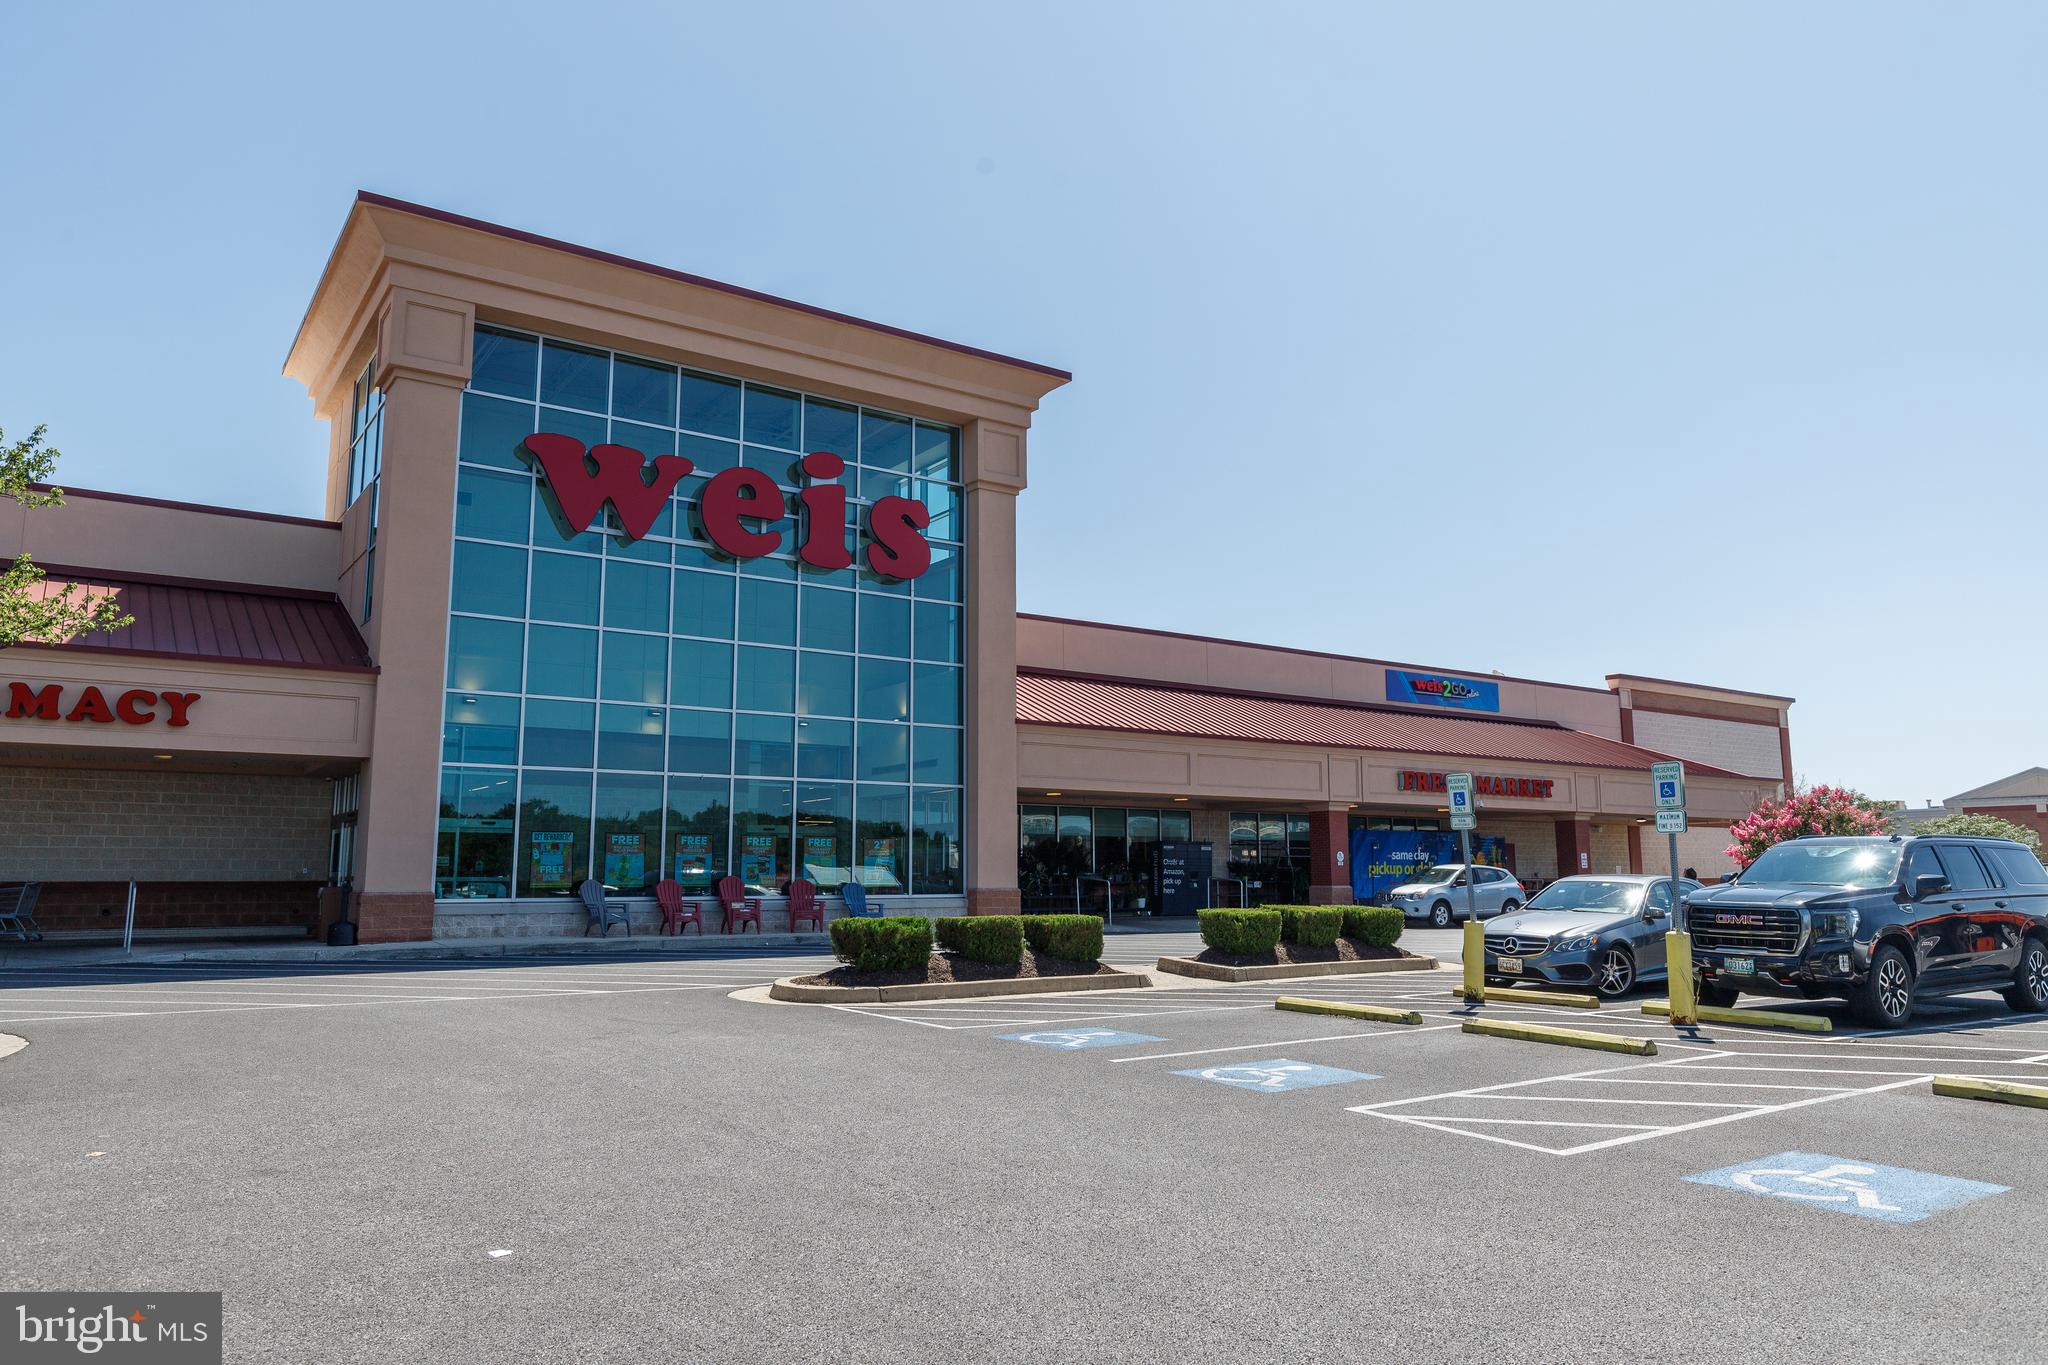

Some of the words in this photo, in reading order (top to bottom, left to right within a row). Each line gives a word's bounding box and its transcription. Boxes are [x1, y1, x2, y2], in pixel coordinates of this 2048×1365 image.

[519, 431, 931, 580] weis
[0, 682, 201, 726] MACY
[1400, 770, 1448, 793] FRE
[1475, 775, 1554, 799] MARKET
[1661, 798, 1676, 806] ONLY
[611, 834, 640, 845] FREE
[680, 835, 708, 846] FREE
[746, 837, 772, 847] FREE
[808, 838, 833, 848] FREE
[1391, 851, 1414, 861] same
[1413, 846, 1430, 863] day
[539, 865, 565, 873] FREE
[1368, 861, 1403, 878] pickup
[1404, 864, 1415, 875] or
[1163, 877, 1174, 886] pick
[1715, 913, 1764, 926] GMC
